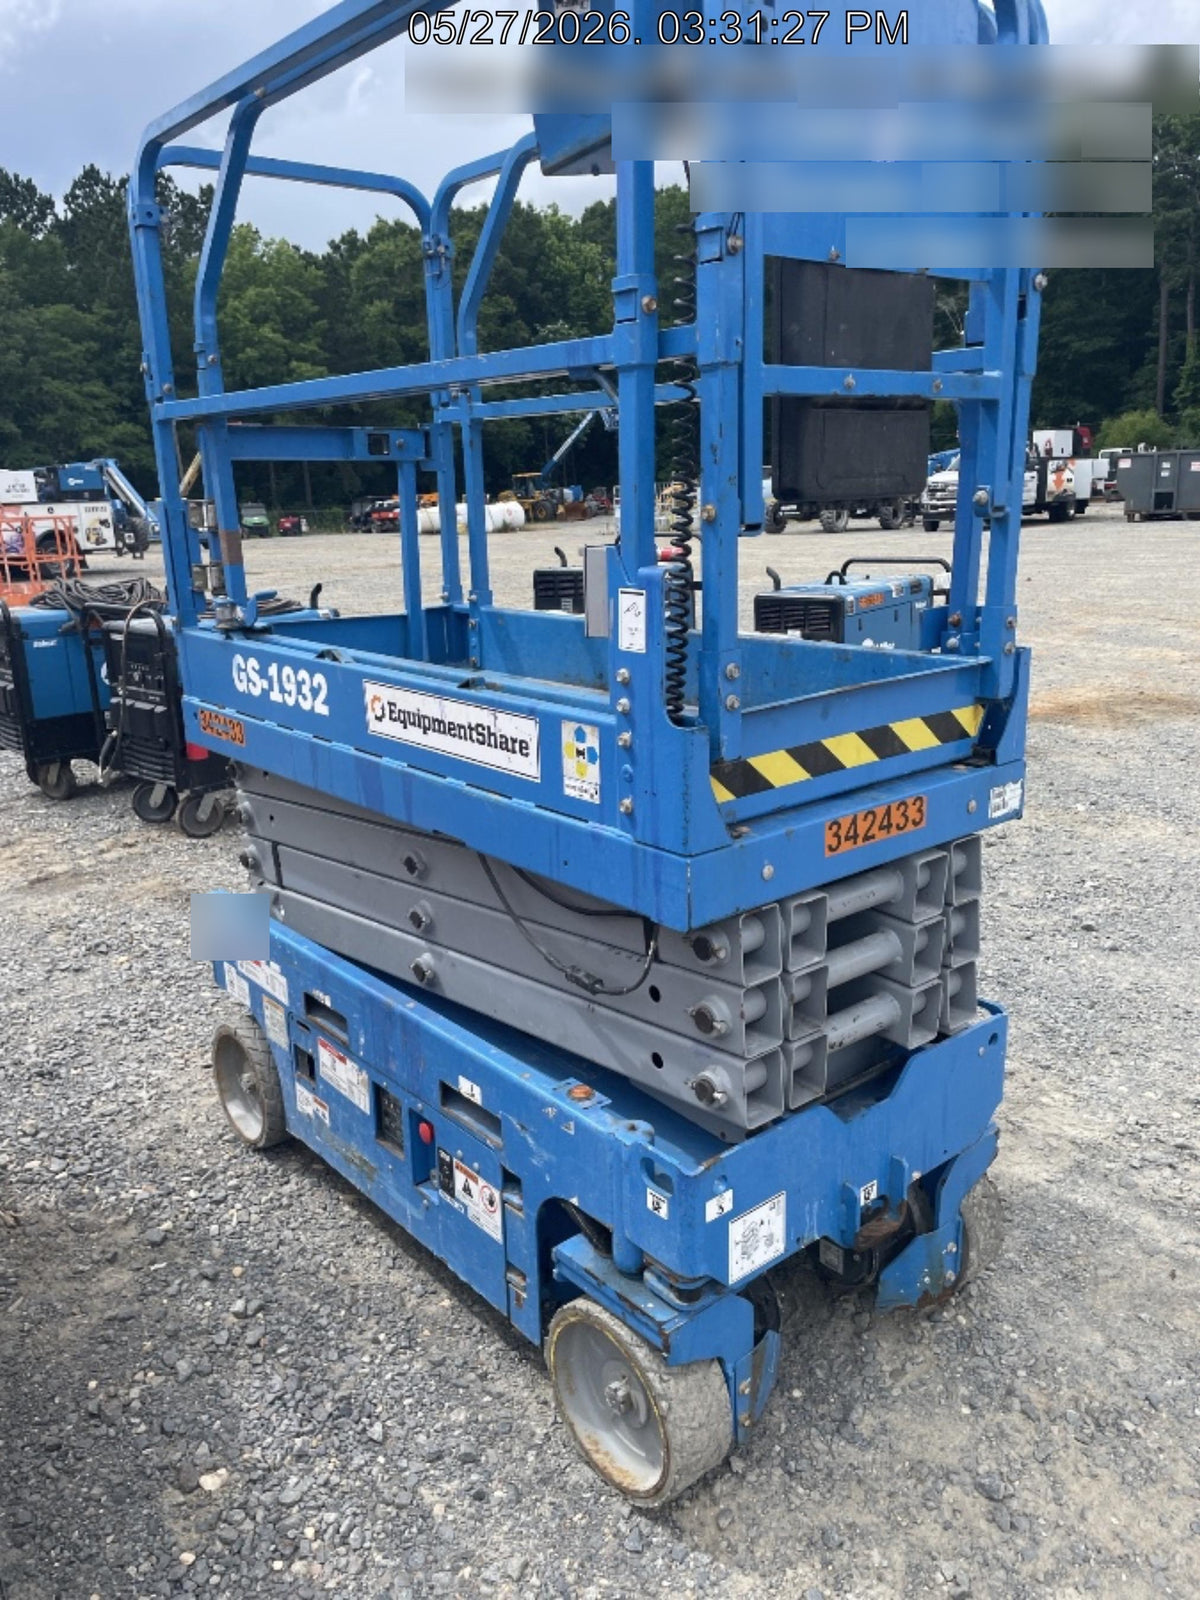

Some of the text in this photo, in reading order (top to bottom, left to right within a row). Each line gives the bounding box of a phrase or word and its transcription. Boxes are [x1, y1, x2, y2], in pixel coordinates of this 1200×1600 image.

[232, 654, 329, 716] GS-1932
[387, 701, 530, 757] EquipmentShare
[827, 796, 925, 852] 342433
